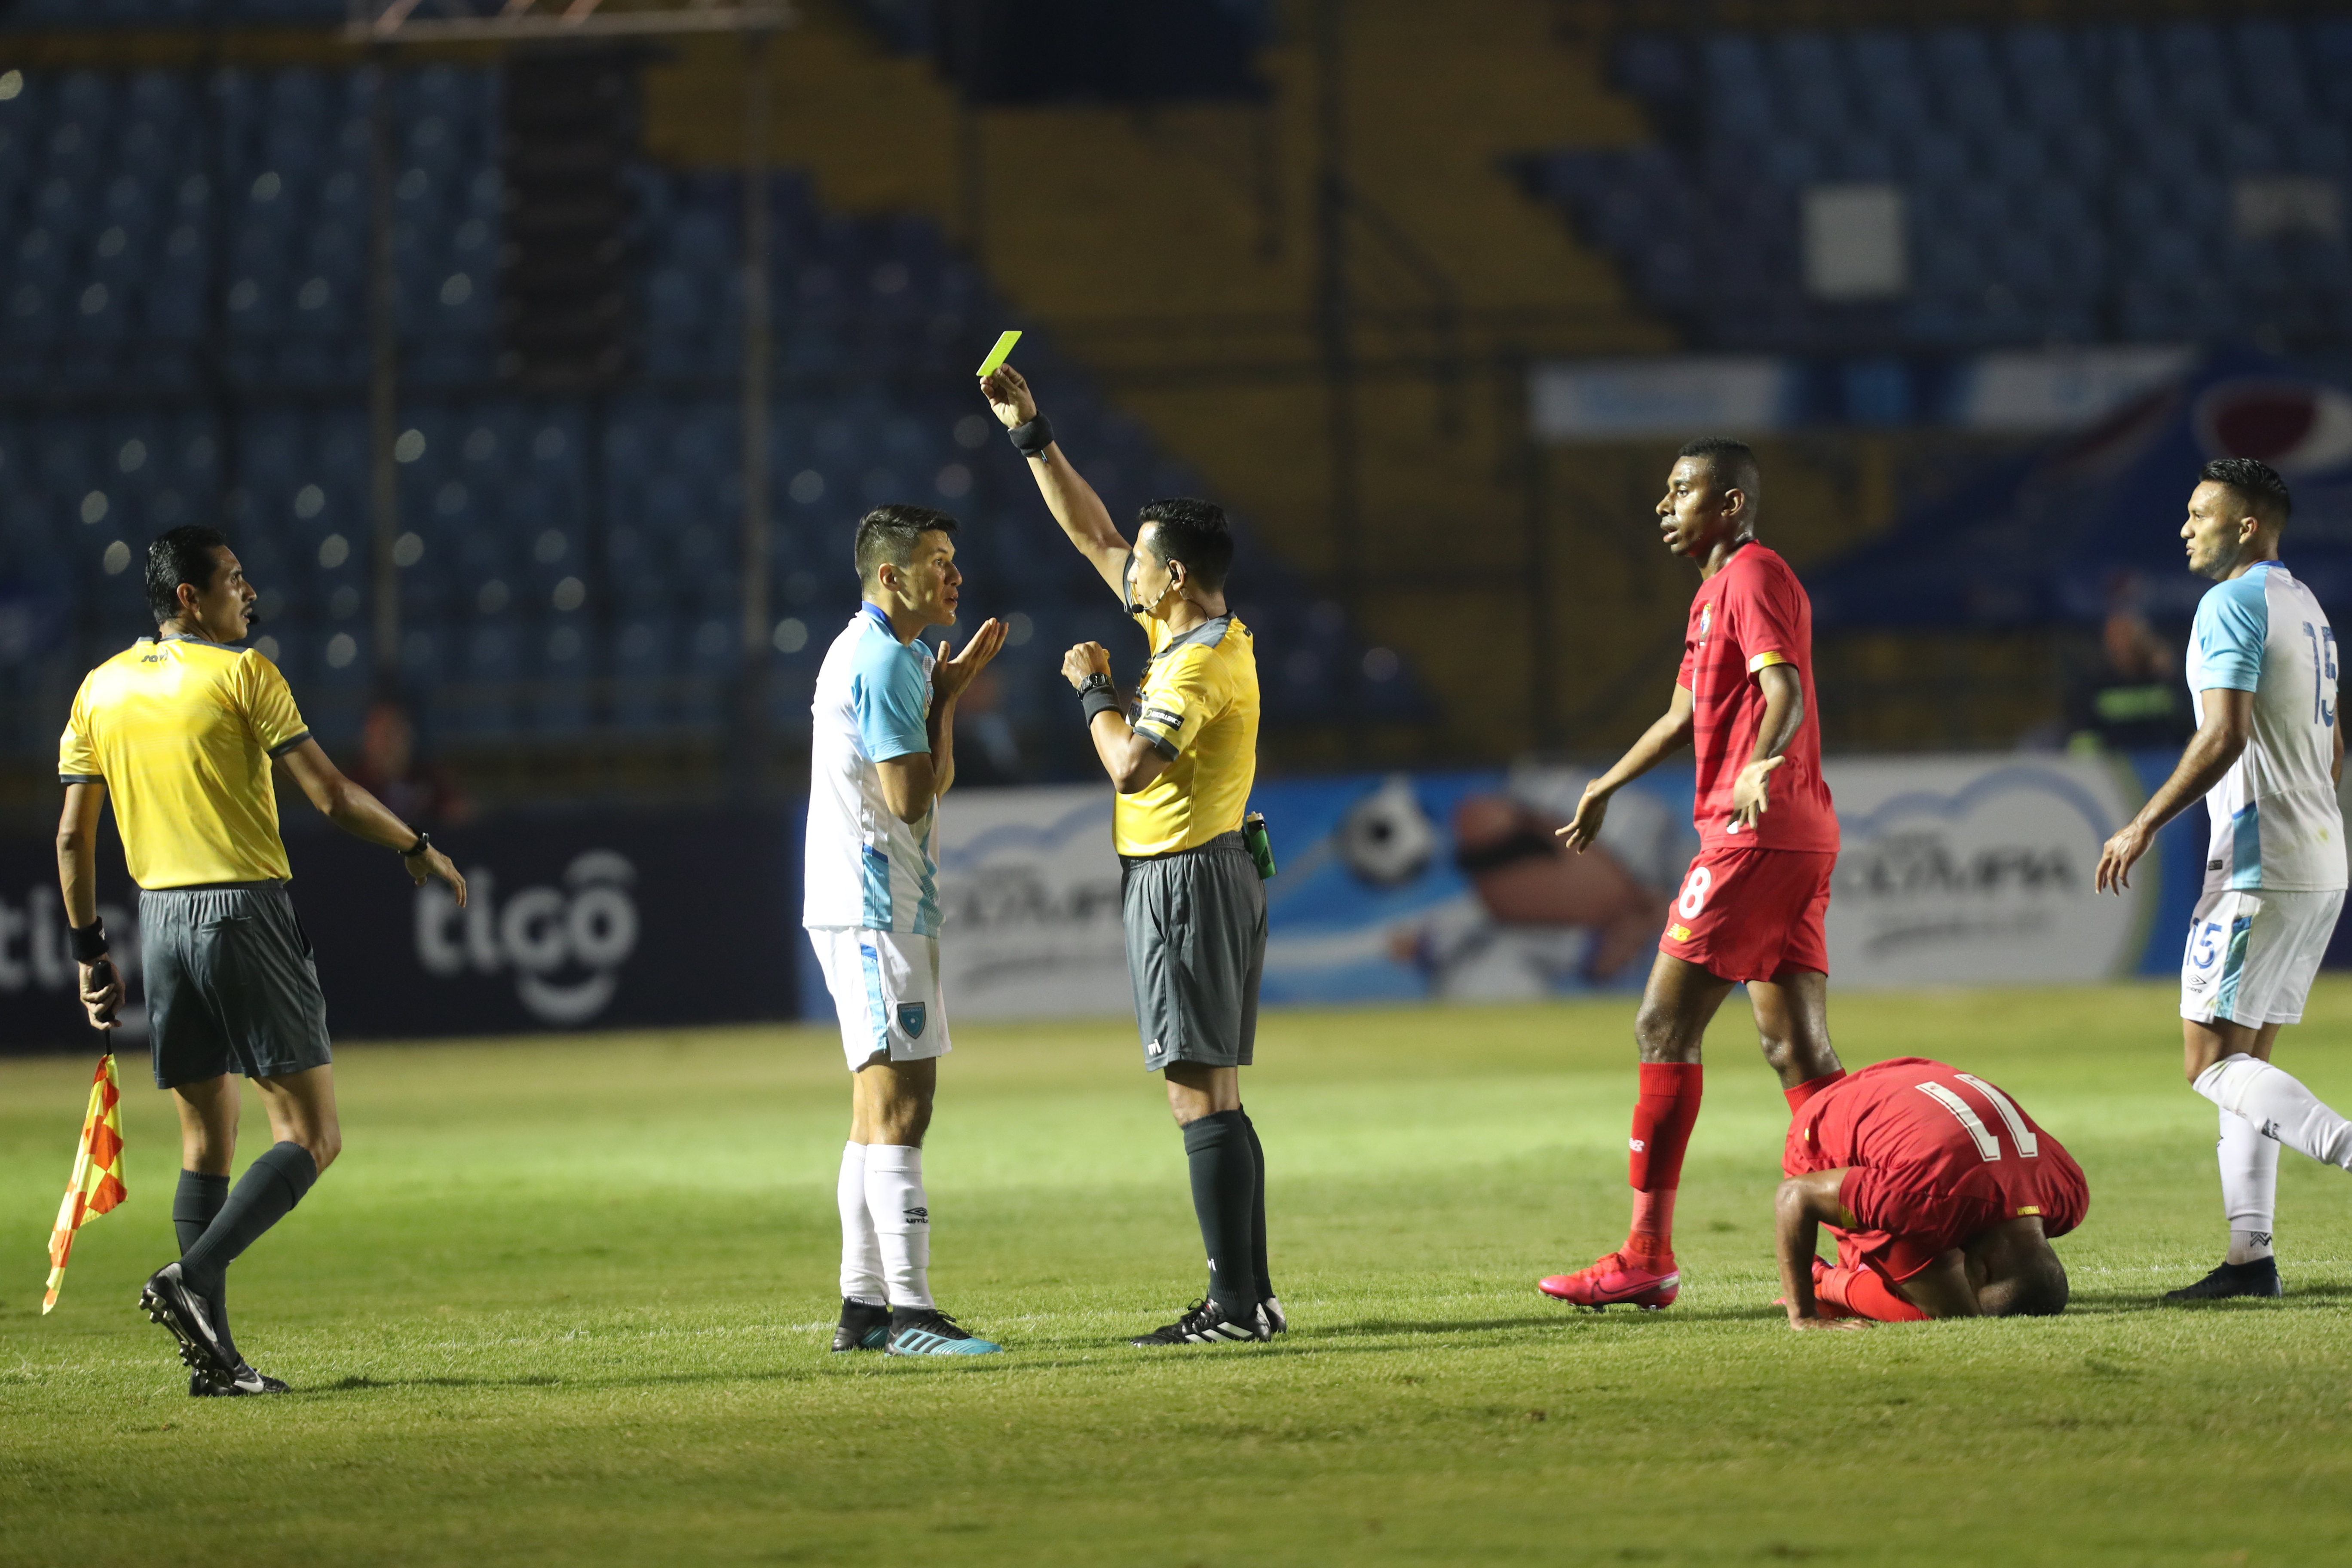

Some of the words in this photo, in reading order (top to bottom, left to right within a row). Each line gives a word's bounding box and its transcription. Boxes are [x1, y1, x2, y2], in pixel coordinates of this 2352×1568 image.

[2302, 621, 2336, 727] 15
[1151, 711, 1182, 726] EXCELLENCE
[1678, 867, 1711, 919] 8
[415, 850, 640, 1025] tigo
[2187, 917, 2222, 969] 15
[1914, 1074, 2038, 1162] 11
